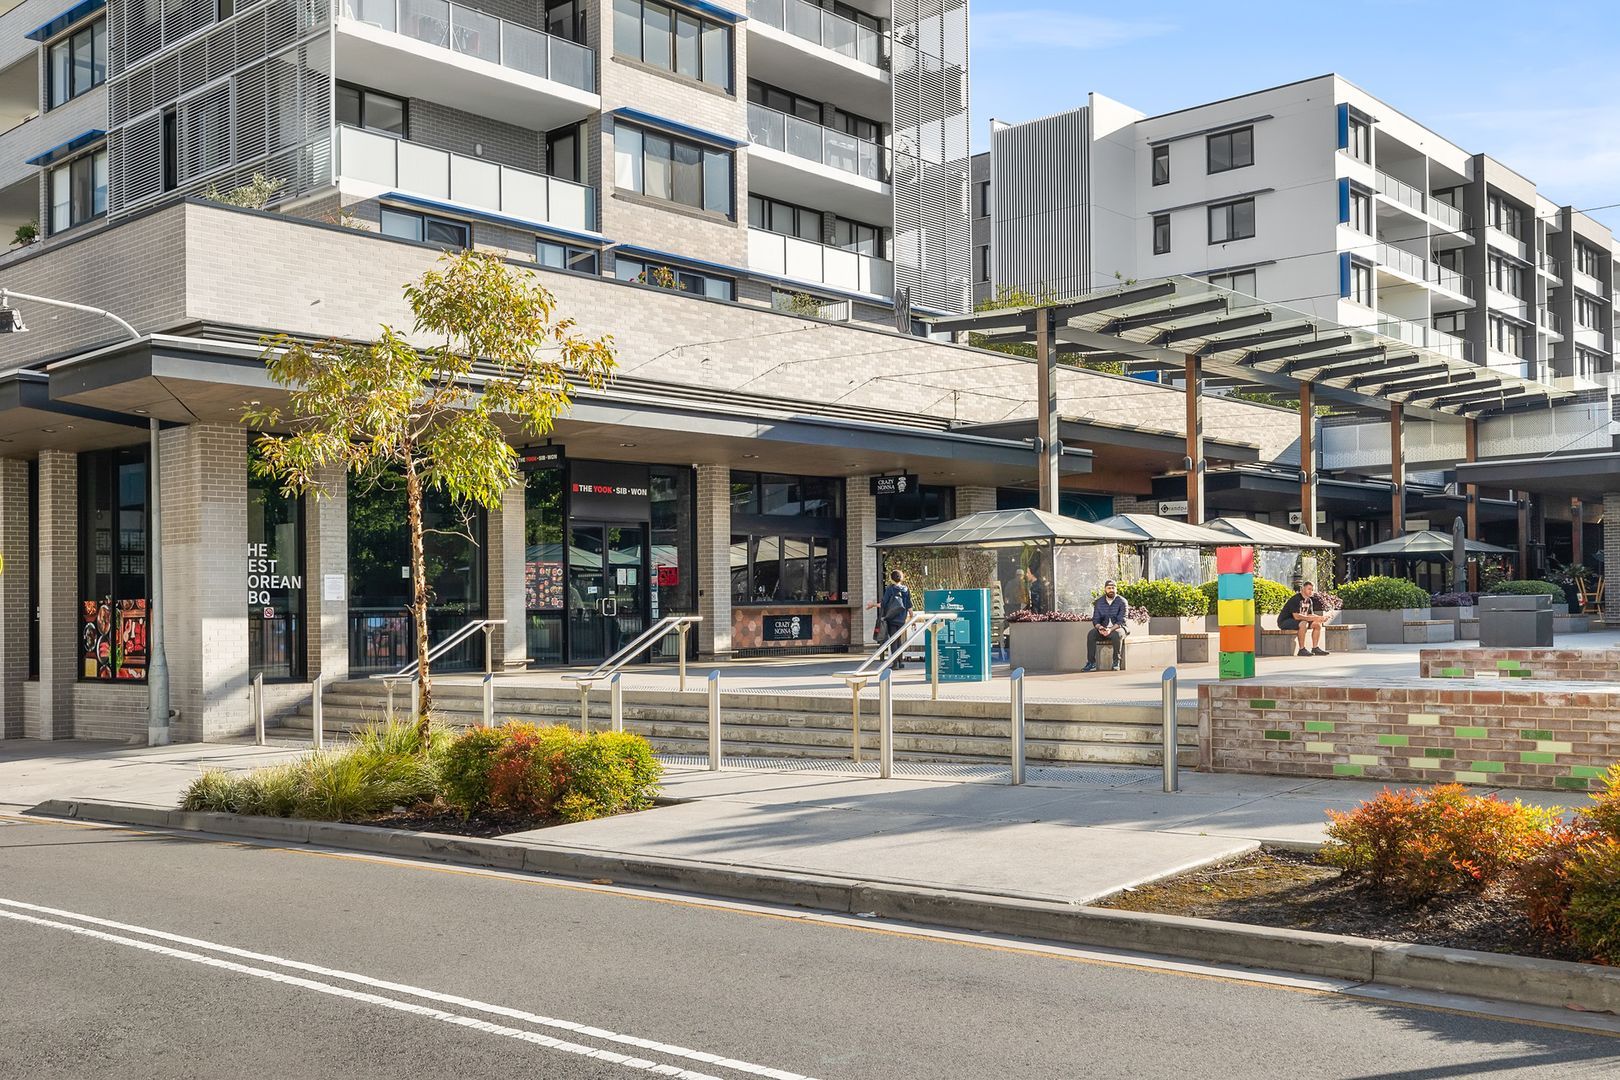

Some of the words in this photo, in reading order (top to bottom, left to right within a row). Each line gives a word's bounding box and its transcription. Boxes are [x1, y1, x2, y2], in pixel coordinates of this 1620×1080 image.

[579, 484, 592, 493] THE
[247, 543, 268, 557] HE
[248, 559, 278, 573] EST
[247, 574, 302, 589] OREAN
[248, 590, 271, 605] BQ
